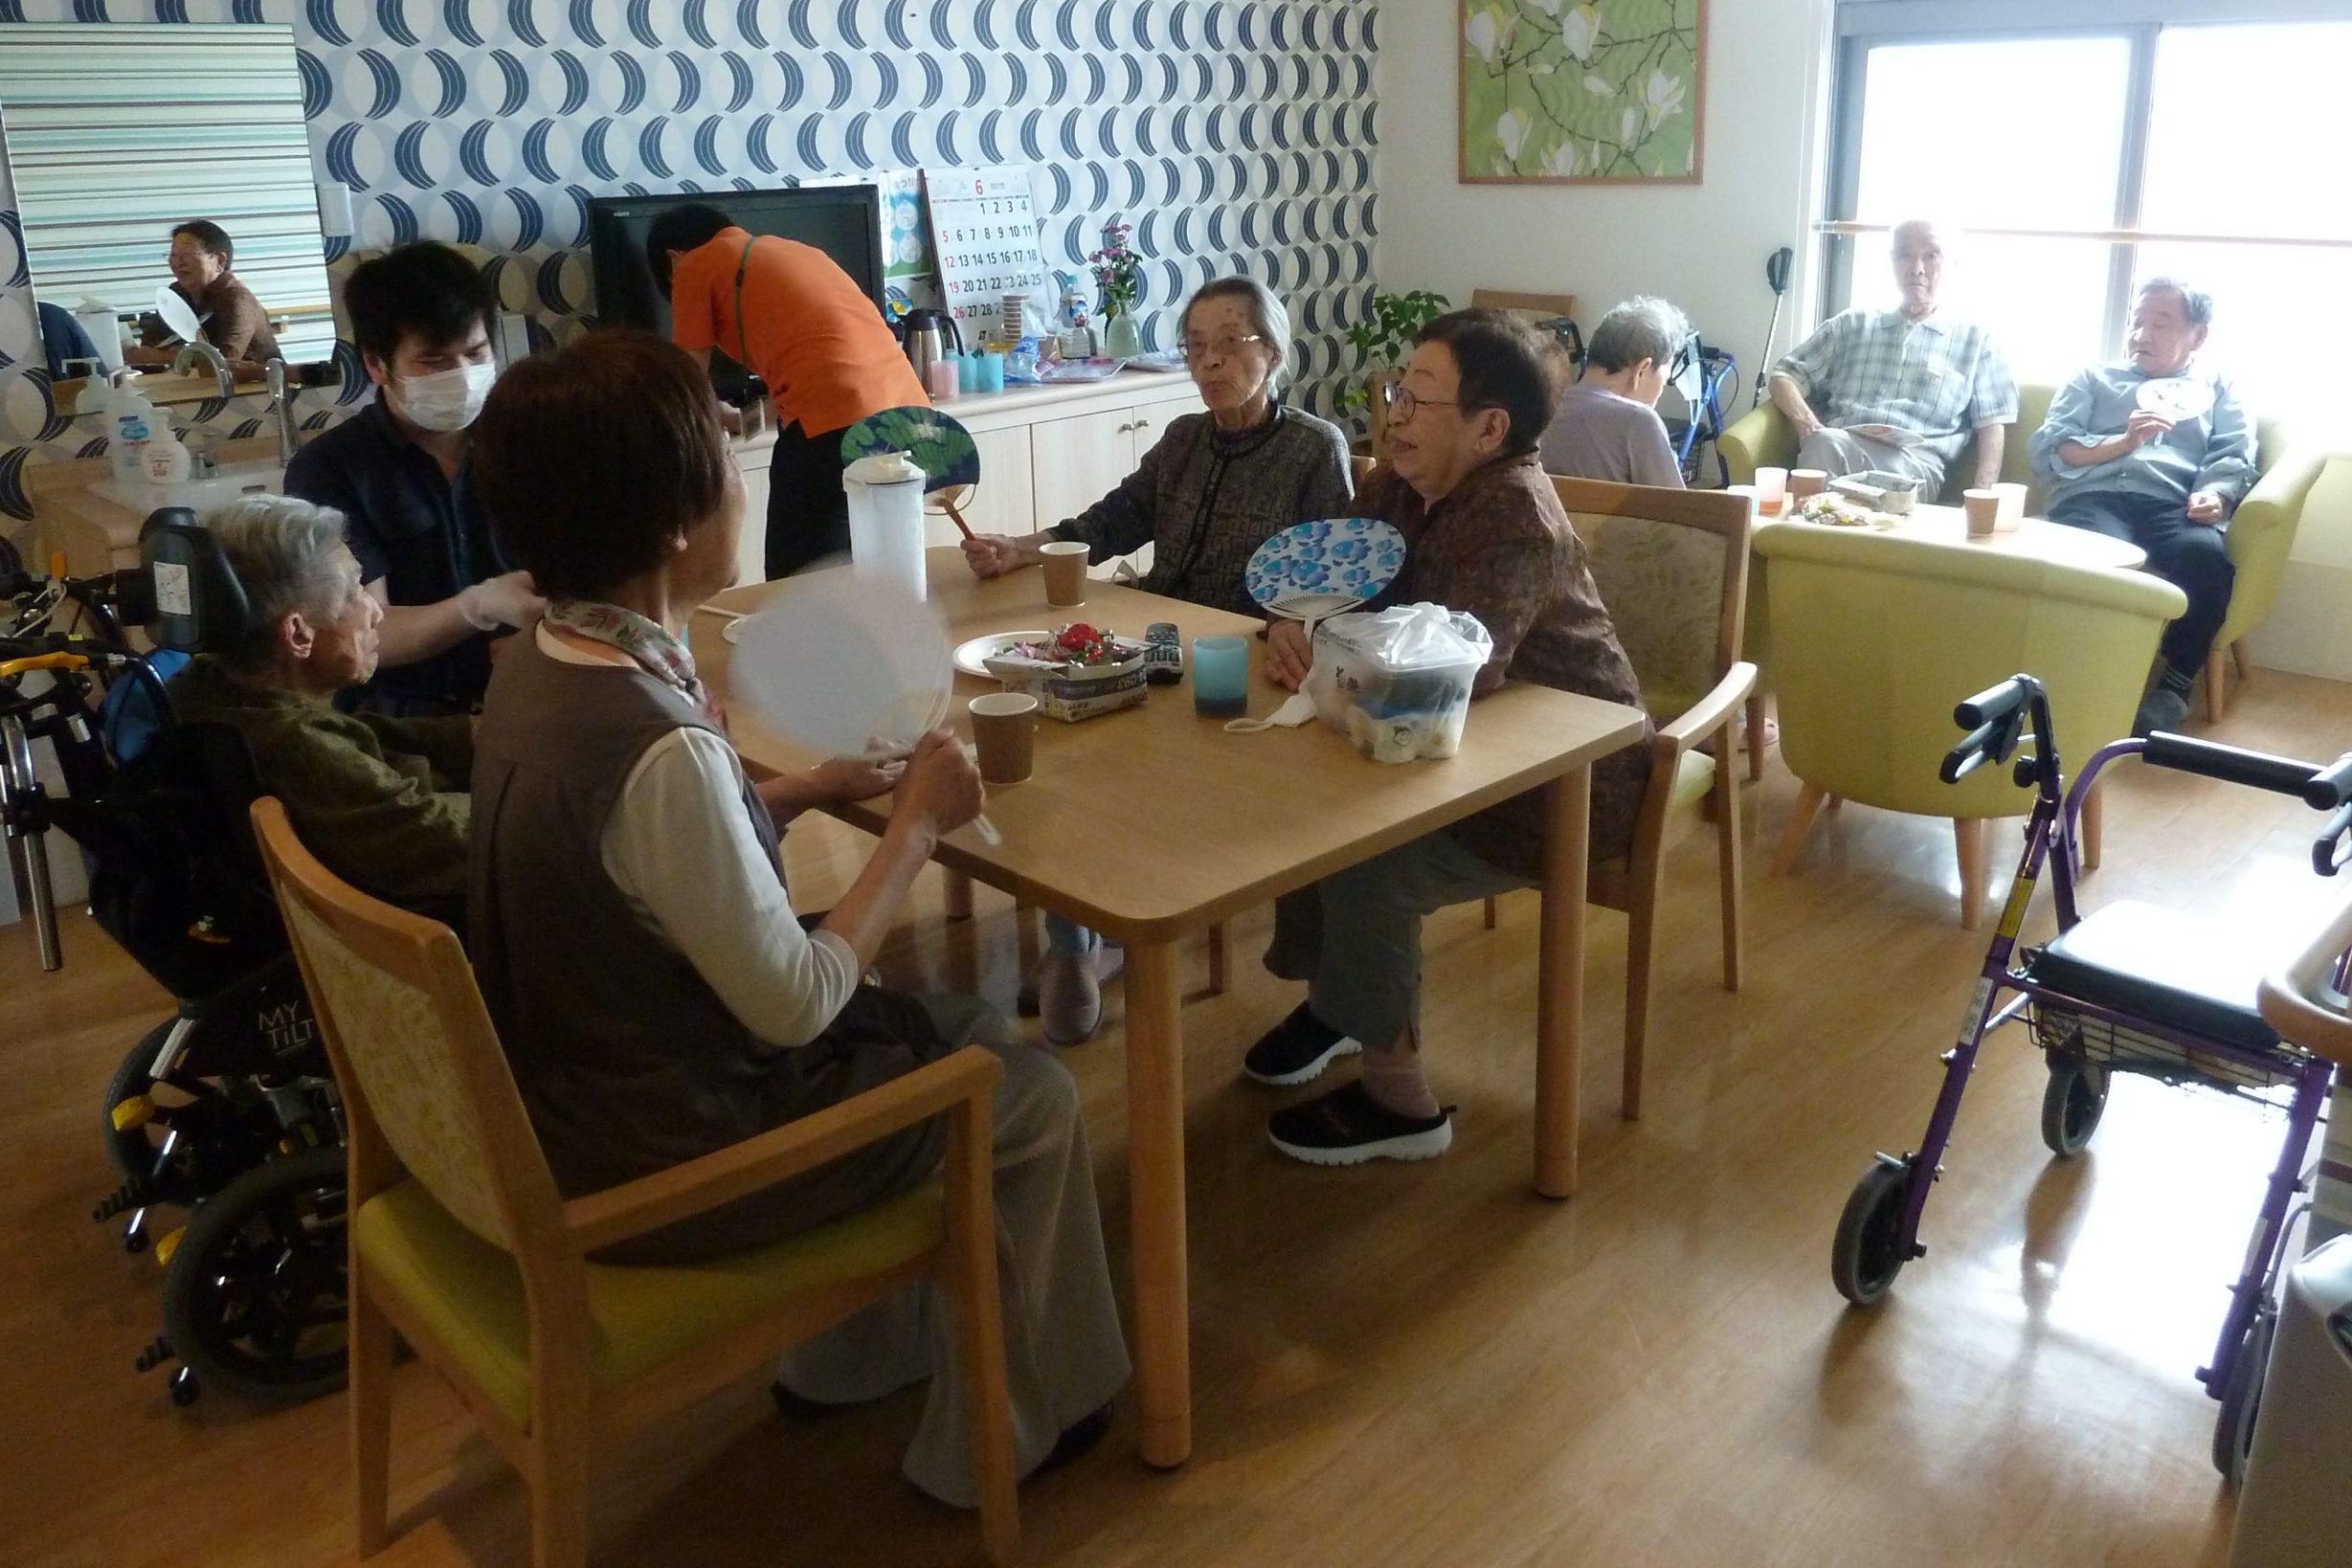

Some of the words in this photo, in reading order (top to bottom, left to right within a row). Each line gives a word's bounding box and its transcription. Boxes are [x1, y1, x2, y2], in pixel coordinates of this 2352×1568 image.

[975, 180, 983, 195] 6
[980, 203, 985, 214] 1
[994, 202, 999, 213] 2
[1008, 201, 1013, 213] 3
[1021, 200, 1027, 211] 4
[943, 231, 949, 242] 5
[957, 230, 962, 241] 6
[970, 229, 975, 240] 7
[985, 228, 990, 239] 8
[998, 227, 1003, 238] 9
[1010, 226, 1019, 236] 10
[1023, 225, 1032, 236] 11
[945, 257, 954, 268] 12
[959, 255, 969, 267] 13
[973, 254, 983, 265] 14
[987, 253, 997, 264] 15
[1000, 251, 1010, 263] 16
[1014, 251, 1022, 262] 17
[1027, 250, 1037, 260] 18
[950, 281, 959, 293] 19
[963, 280, 974, 292] 20
[977, 279, 987, 291] 21
[991, 278, 1001, 289] 22
[1018, 275, 1028, 286] 24
[1031, 274, 1042, 286] 25
[953, 306, 965, 319] 26
[967, 305, 977, 317] 27
[981, 304, 992, 316] 28
[258, 999, 299, 1031] MY
[267, 1018, 314, 1049] TILT
